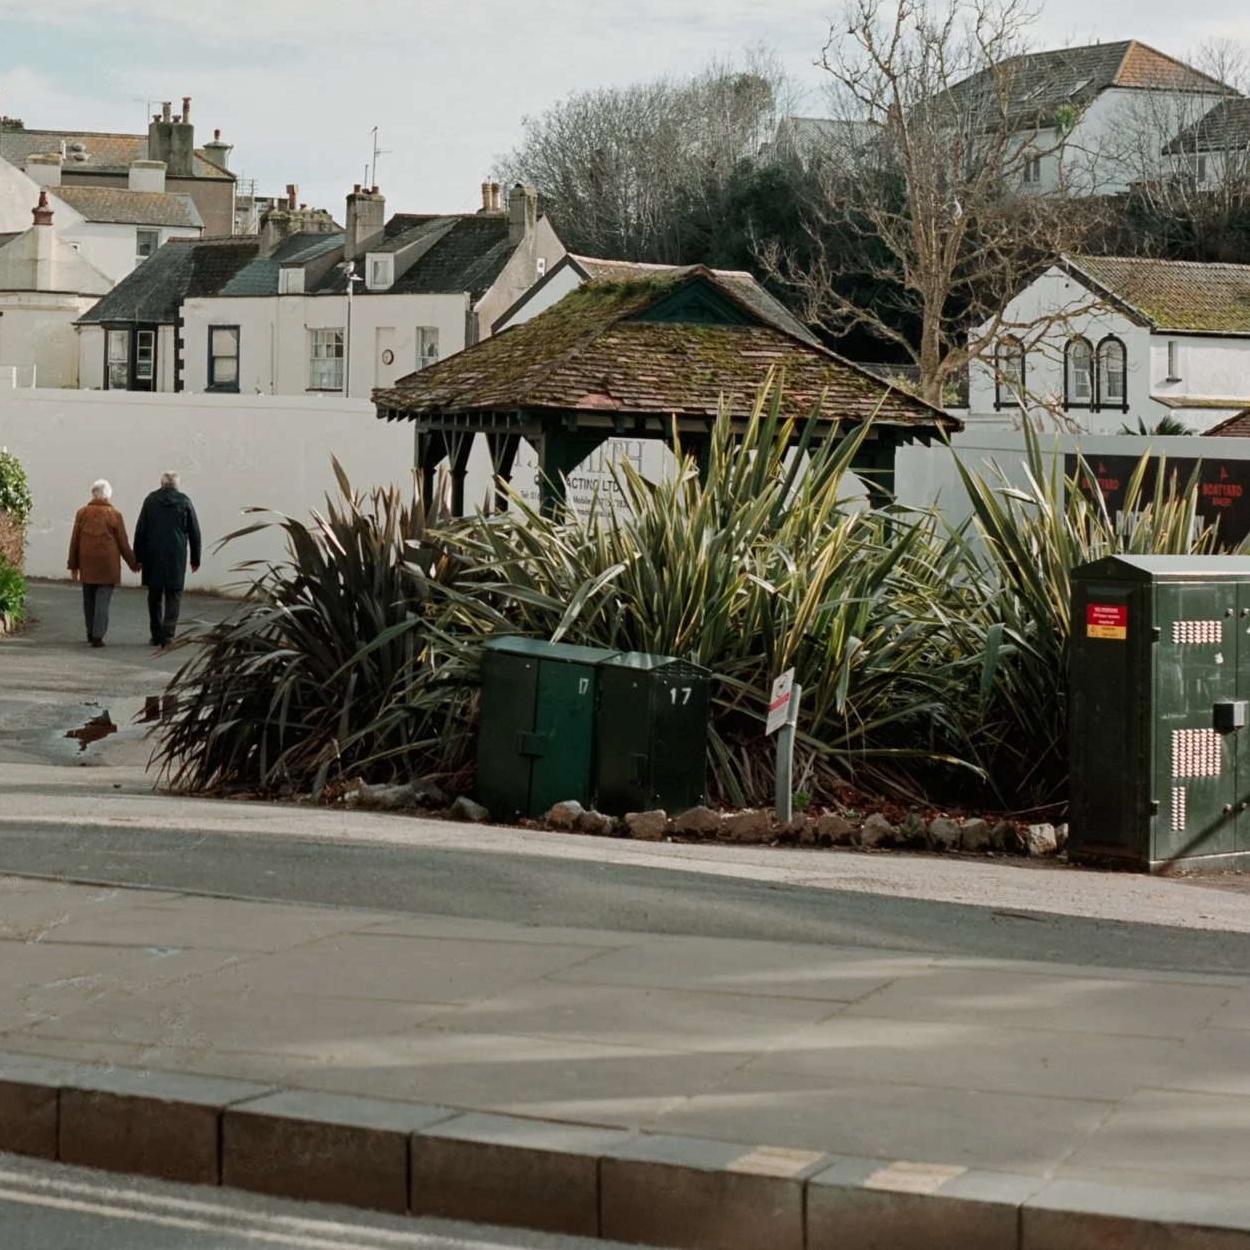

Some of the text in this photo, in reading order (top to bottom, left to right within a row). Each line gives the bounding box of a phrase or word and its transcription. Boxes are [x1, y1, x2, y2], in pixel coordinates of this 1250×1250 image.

[603, 480, 621, 493] LTD
[1203, 483, 1243, 497] BOATYARD
[579, 677, 589, 695] 17
[670, 687, 693, 705] 17
